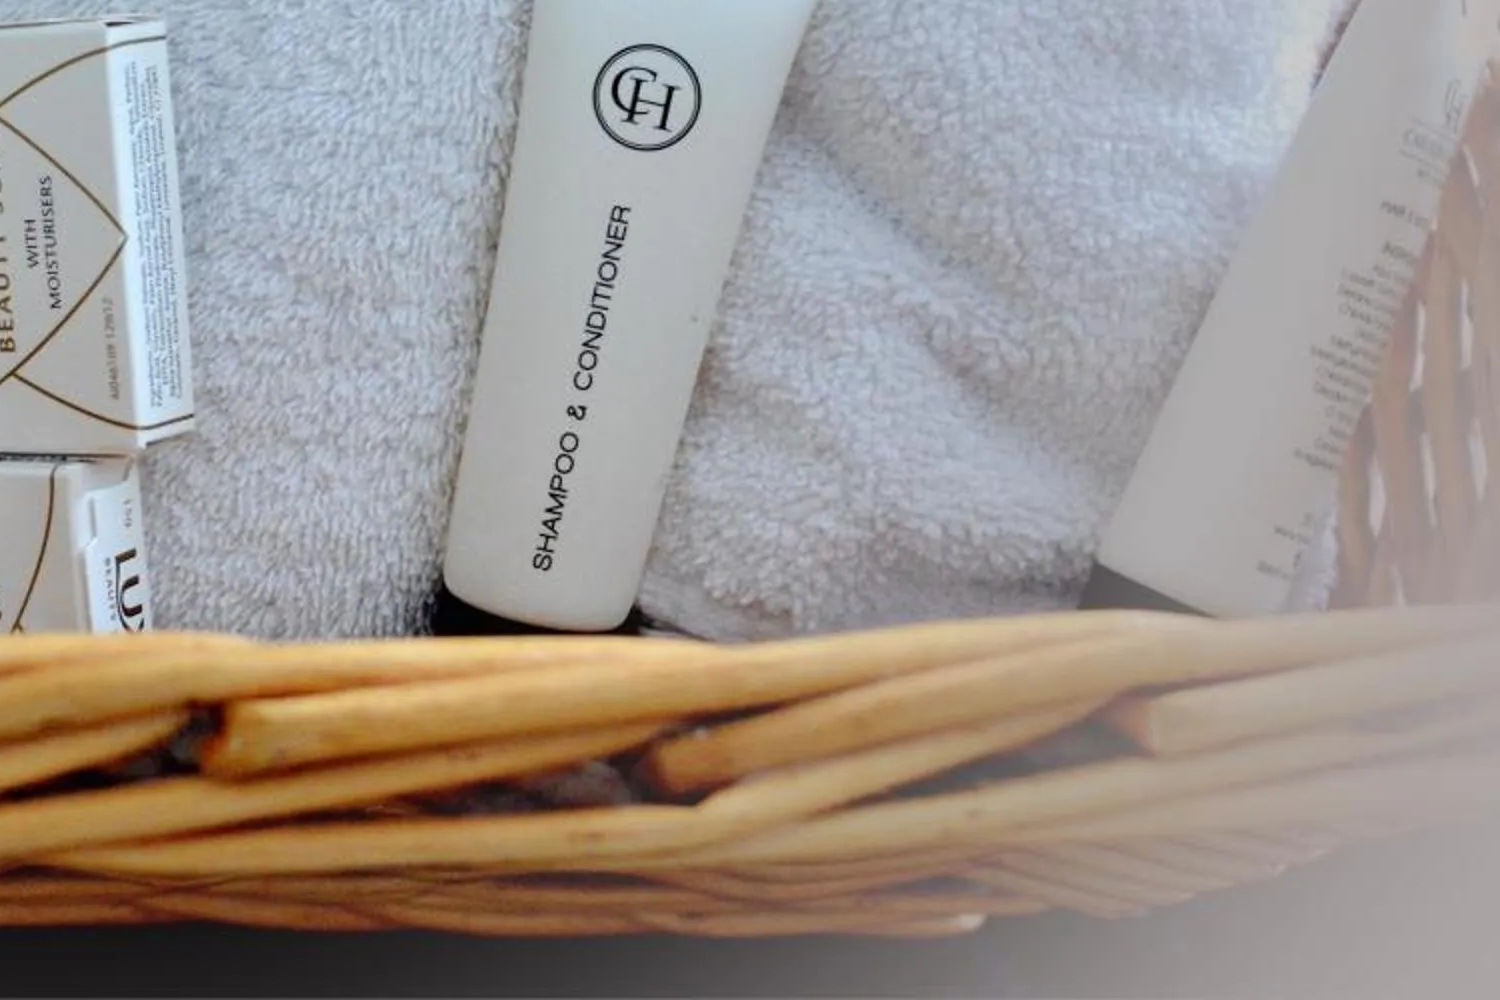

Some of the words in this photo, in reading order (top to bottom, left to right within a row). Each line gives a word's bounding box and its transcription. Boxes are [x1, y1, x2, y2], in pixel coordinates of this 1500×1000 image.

[23, 218, 40, 269] WITH
[38, 174, 62, 310] MOISTURISERS
[573, 203, 632, 392] CONDITIONER
[566, 404, 587, 422] &
[532, 430, 580, 573] SHAMPOO
